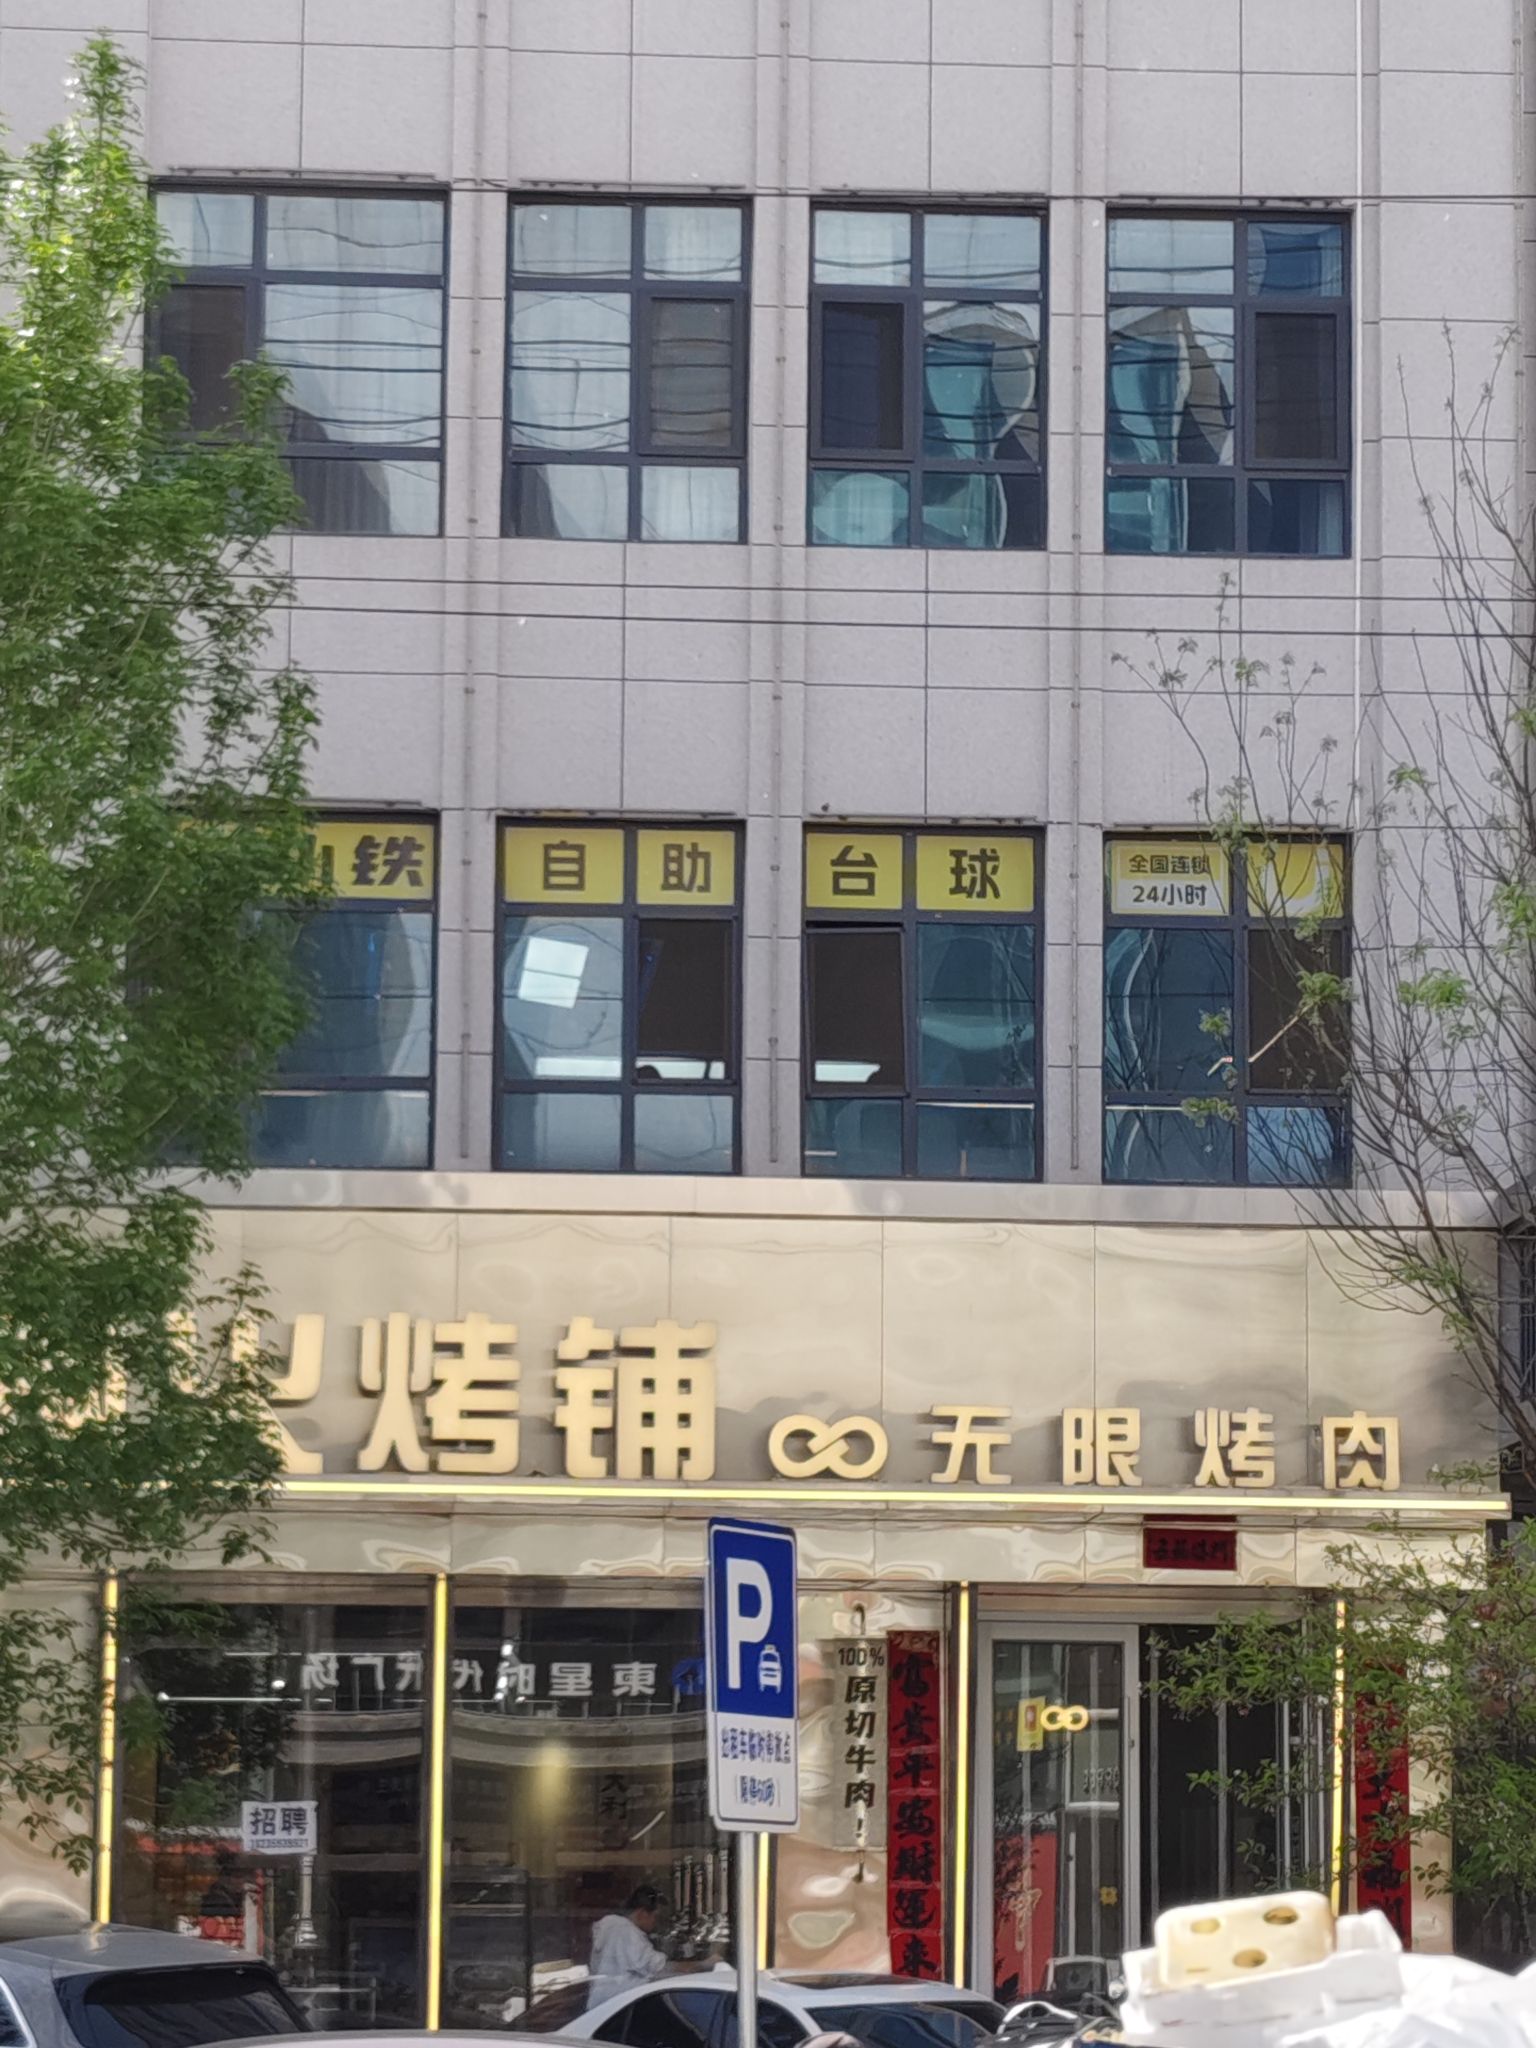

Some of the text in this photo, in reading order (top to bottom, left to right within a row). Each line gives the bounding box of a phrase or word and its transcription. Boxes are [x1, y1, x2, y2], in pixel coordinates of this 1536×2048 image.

[1128, 853, 1211, 875] 全国连锁
[1131, 883, 1208, 906] 24小时
[930, 1405, 1401, 1489] 无限烤肉
[726, 1556, 774, 1690] P
[838, 1646, 886, 1668] 100%
[249, 1807, 309, 1836] 招聘
